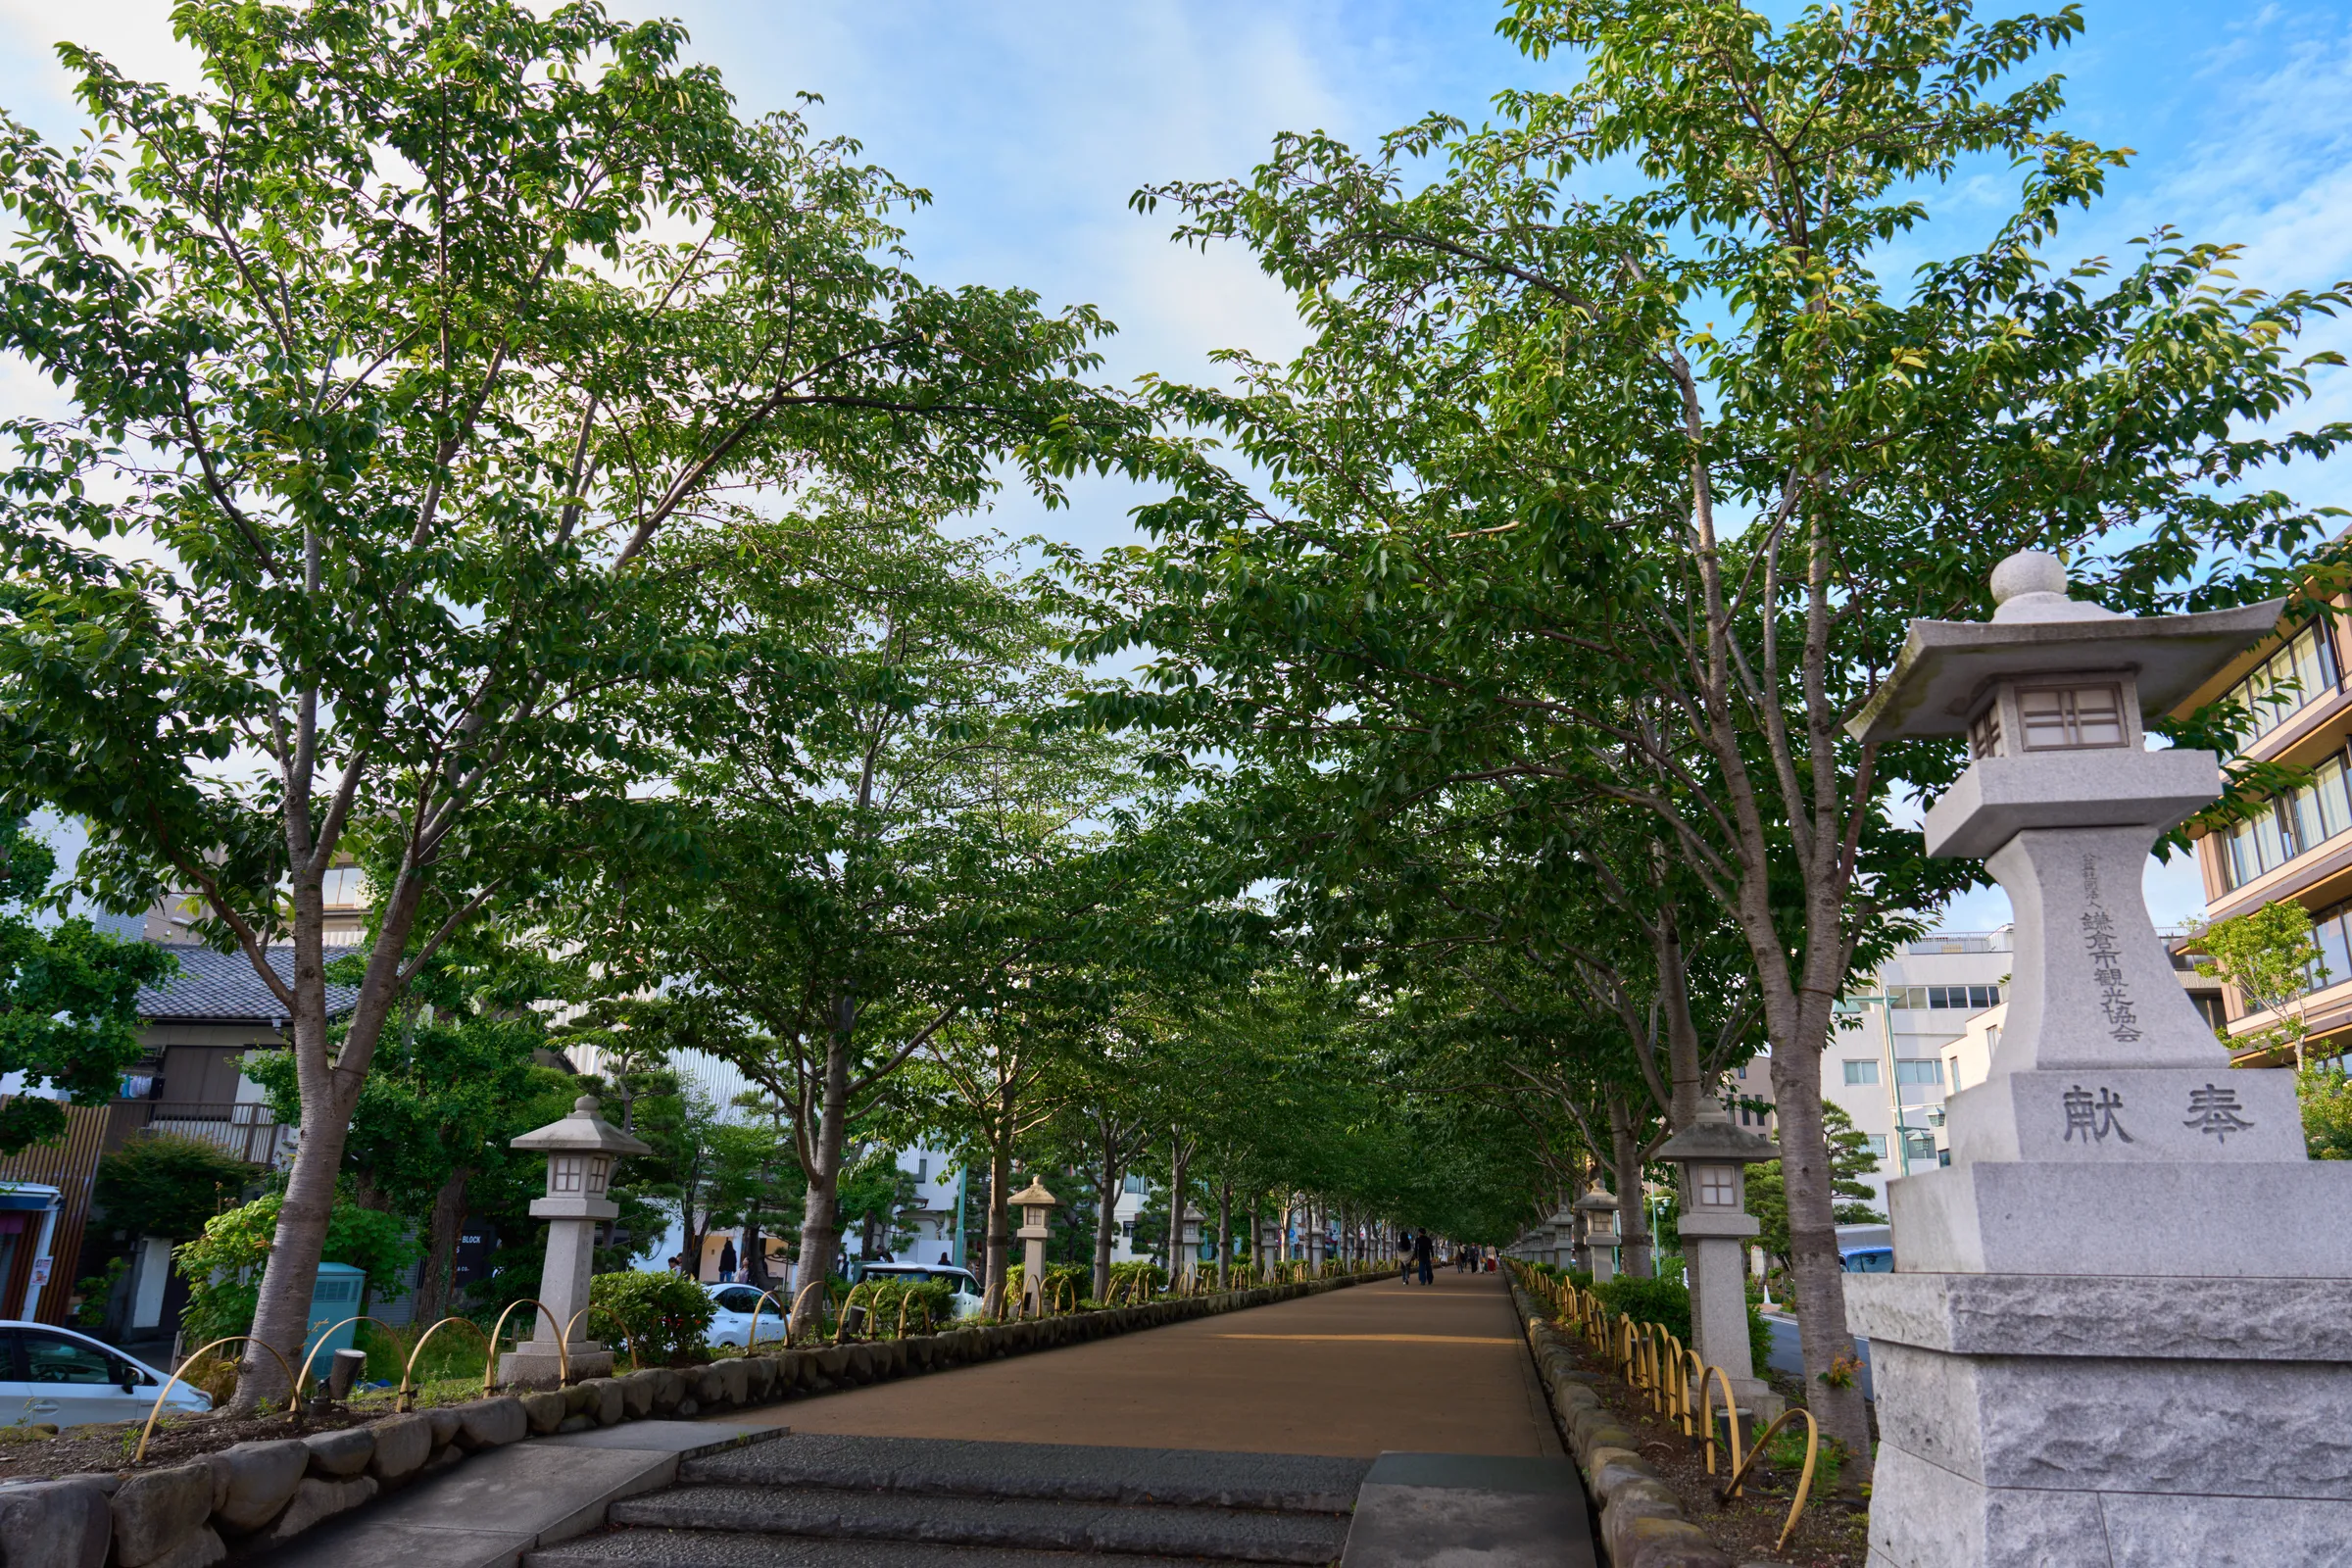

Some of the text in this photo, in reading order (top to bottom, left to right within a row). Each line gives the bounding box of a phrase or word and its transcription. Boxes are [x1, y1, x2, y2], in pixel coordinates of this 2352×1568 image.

[2080, 911, 2143, 1043] 鎌倉市観光協会
